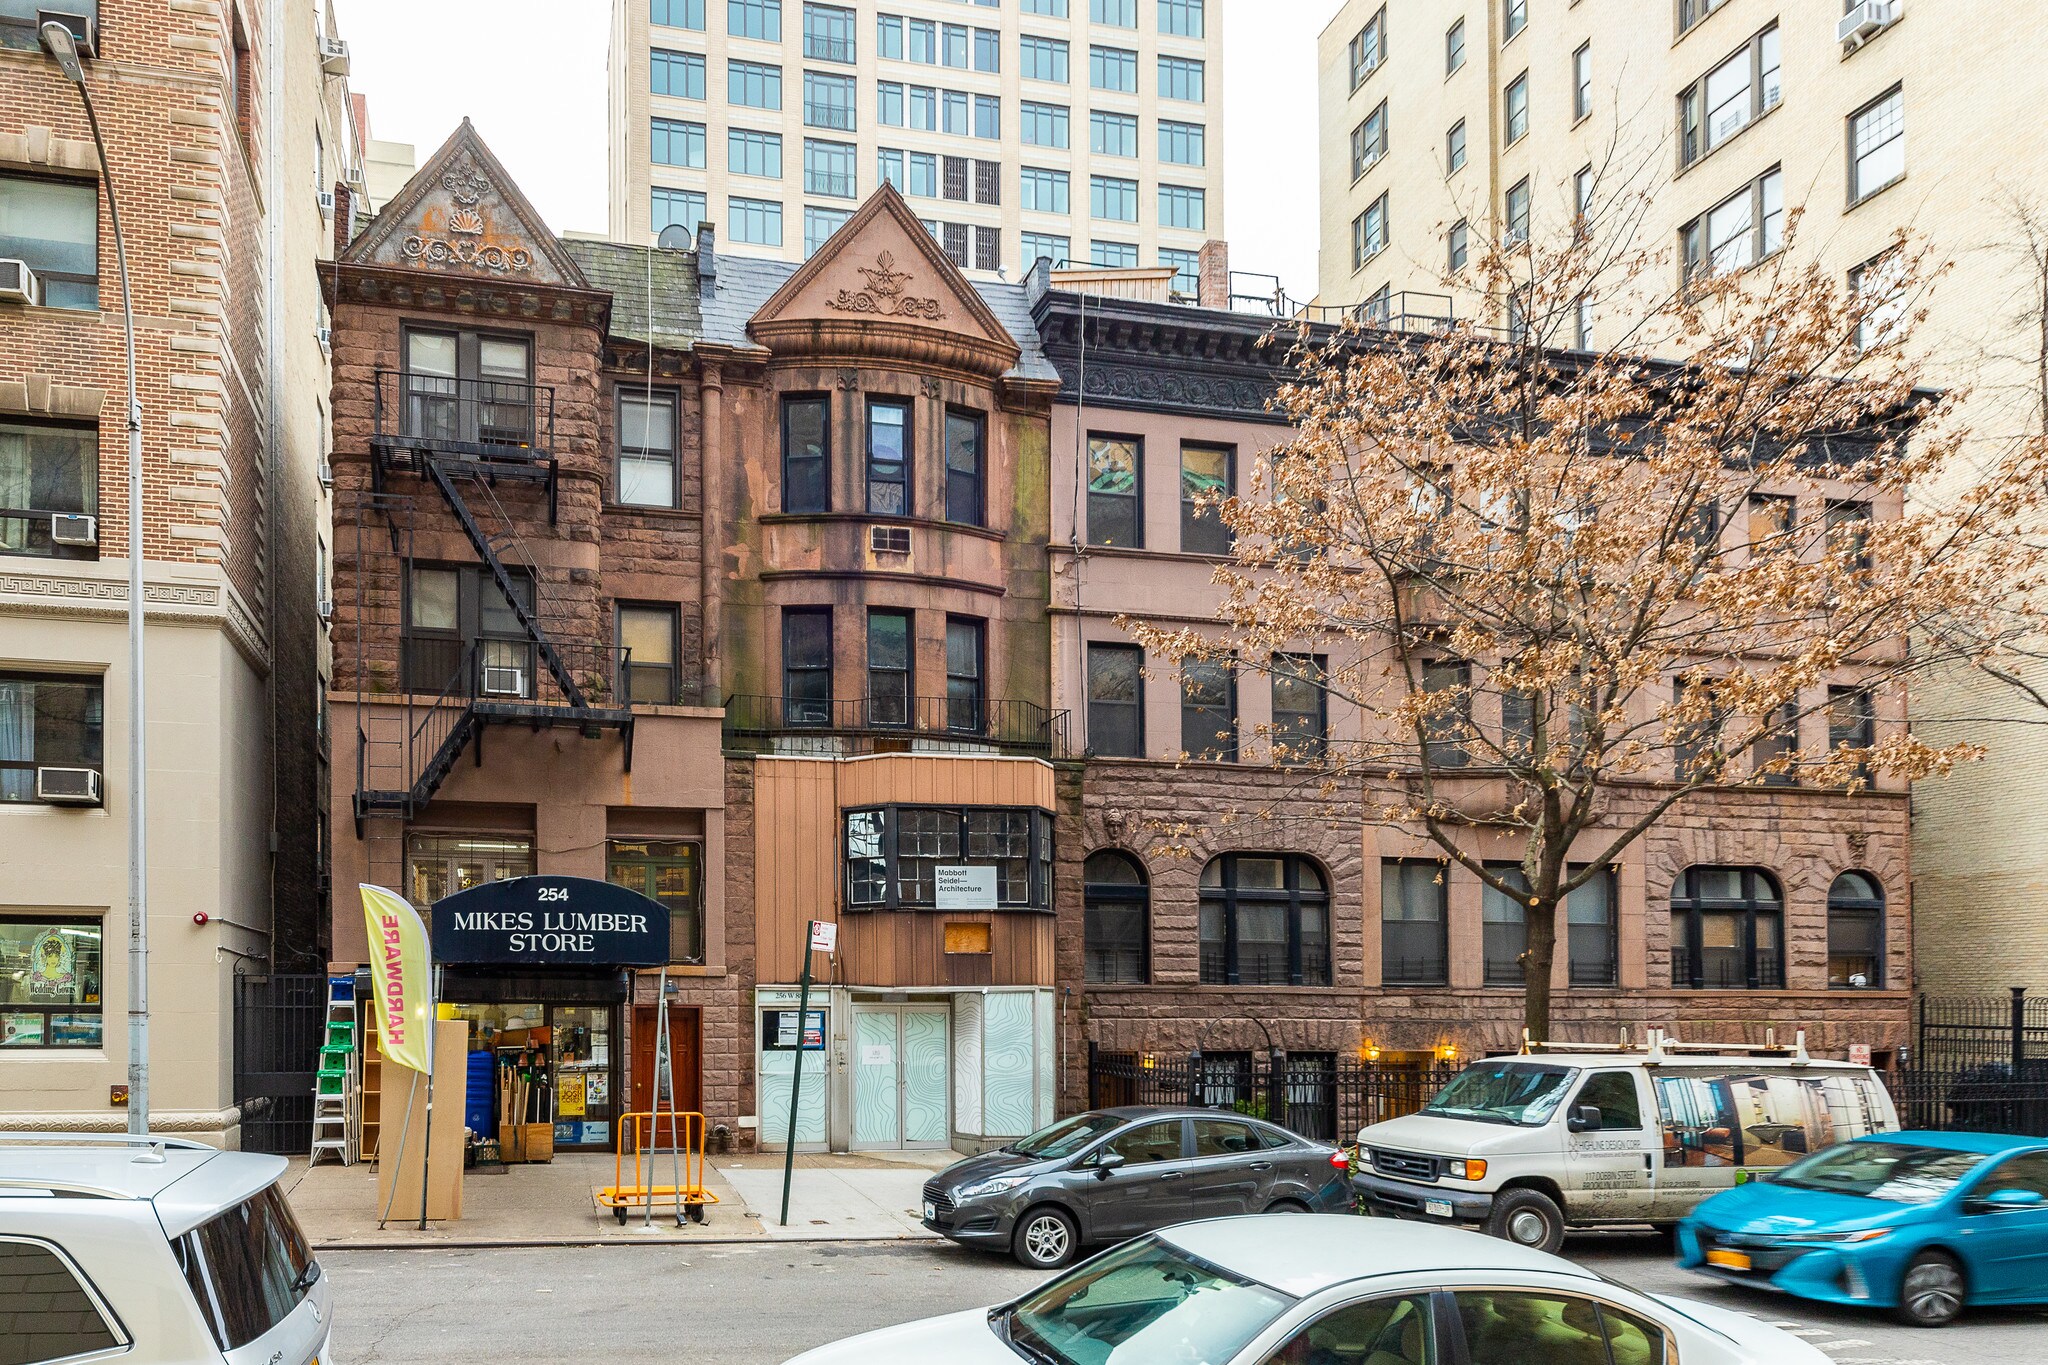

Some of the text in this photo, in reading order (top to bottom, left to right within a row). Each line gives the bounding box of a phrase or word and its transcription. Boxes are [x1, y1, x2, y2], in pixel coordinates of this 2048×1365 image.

[538, 887, 569, 901] 254
[453, 912, 648, 933] MIKES LUMBER
[509, 933, 595, 952] STORE
[30, 983, 76, 998] Wedding Gowns
[1579, 1140, 1605, 1150] HIGHLINE
[1606, 1140, 1626, 1150] DESIGN
[1585, 1170, 1637, 1181] 117 DOBBIN STREET
